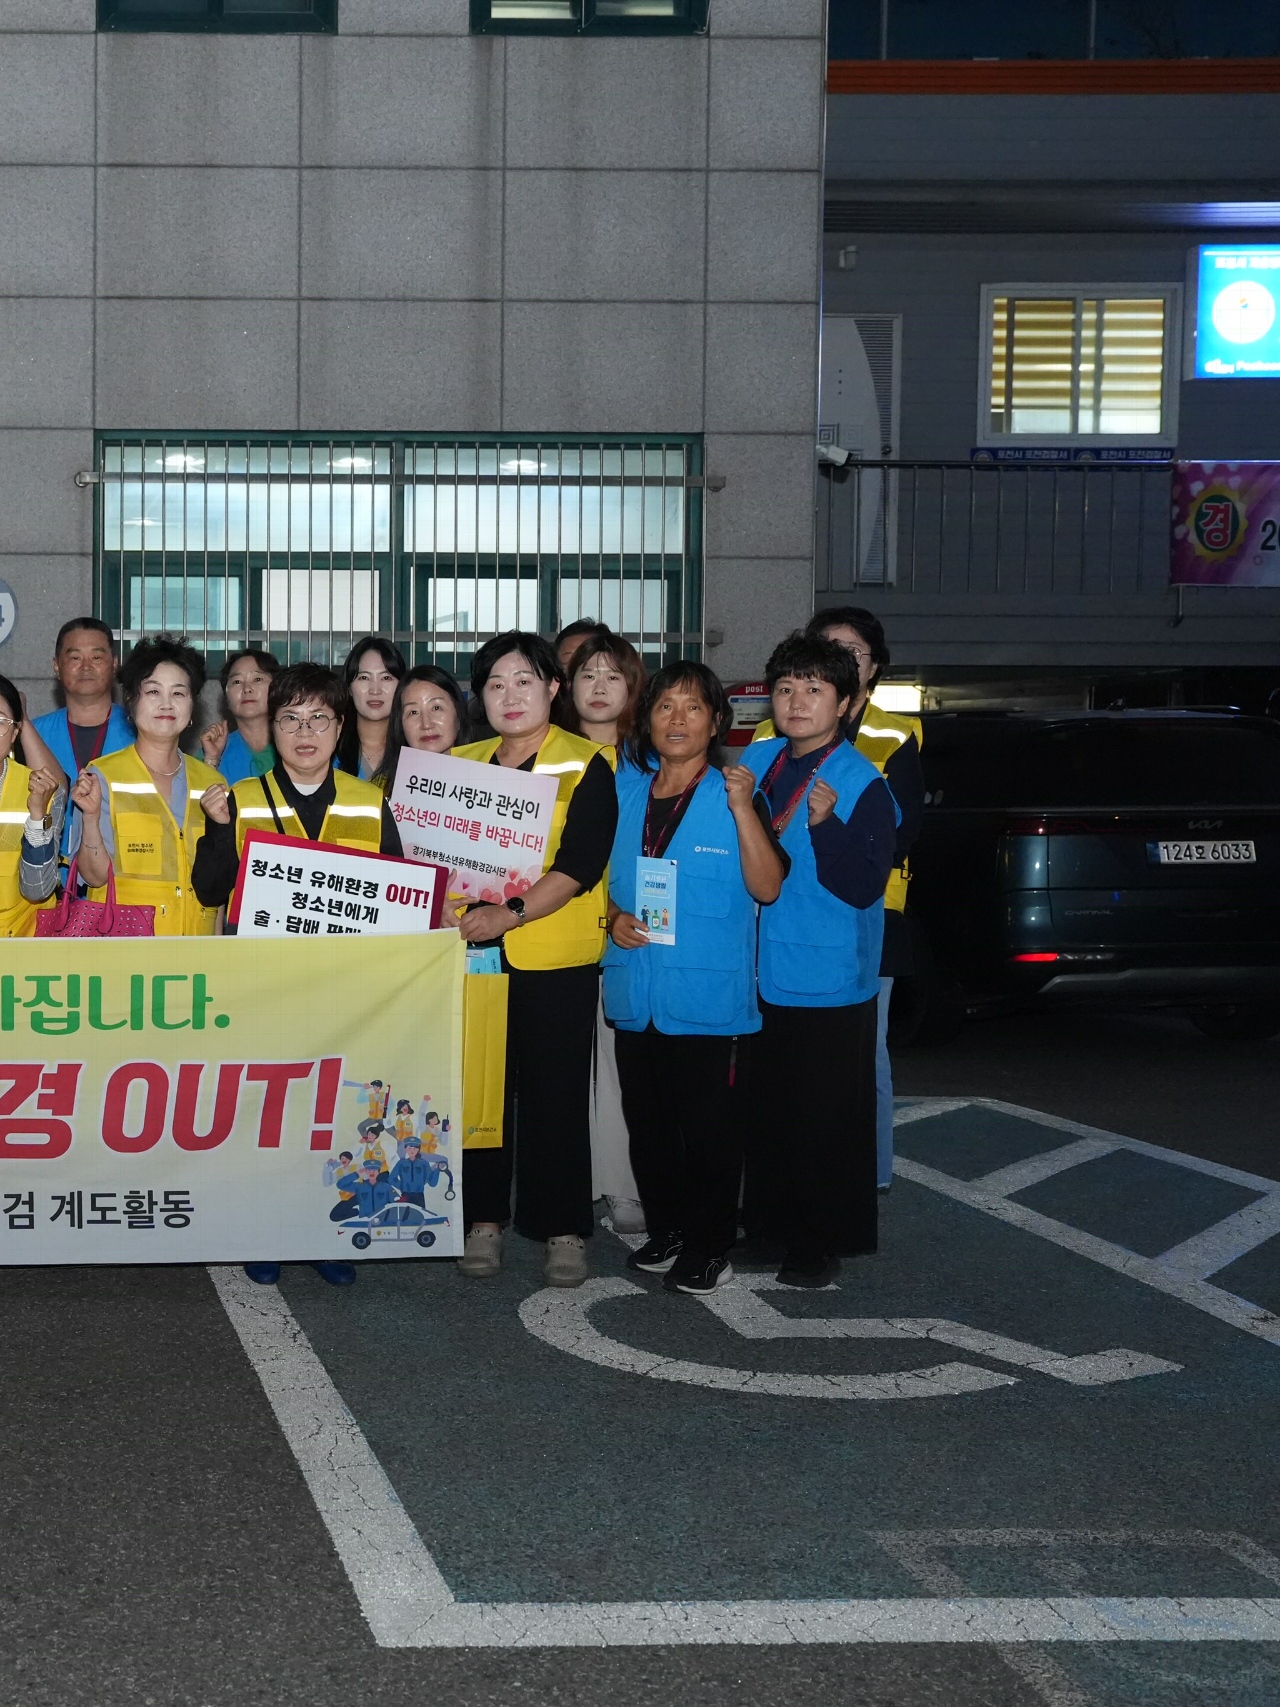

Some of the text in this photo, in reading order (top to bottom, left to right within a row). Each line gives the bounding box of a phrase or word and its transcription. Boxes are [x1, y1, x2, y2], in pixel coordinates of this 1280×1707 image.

[1200, 502, 1233, 549] 경
[405, 774, 540, 820] 우리의 사랑과 관심이
[392, 802, 544, 853] 청소년의 미래를 바꿉니다!
[250, 859, 430, 910] 청소년 유해환경 OUT!
[412, 845, 507, 878] 경기북부청소년유해환경감시단
[291, 891, 380, 925] 청소년에게
[101, 1057, 343, 1154] OUT!
[49, 1189, 195, 1230] 계도활동
